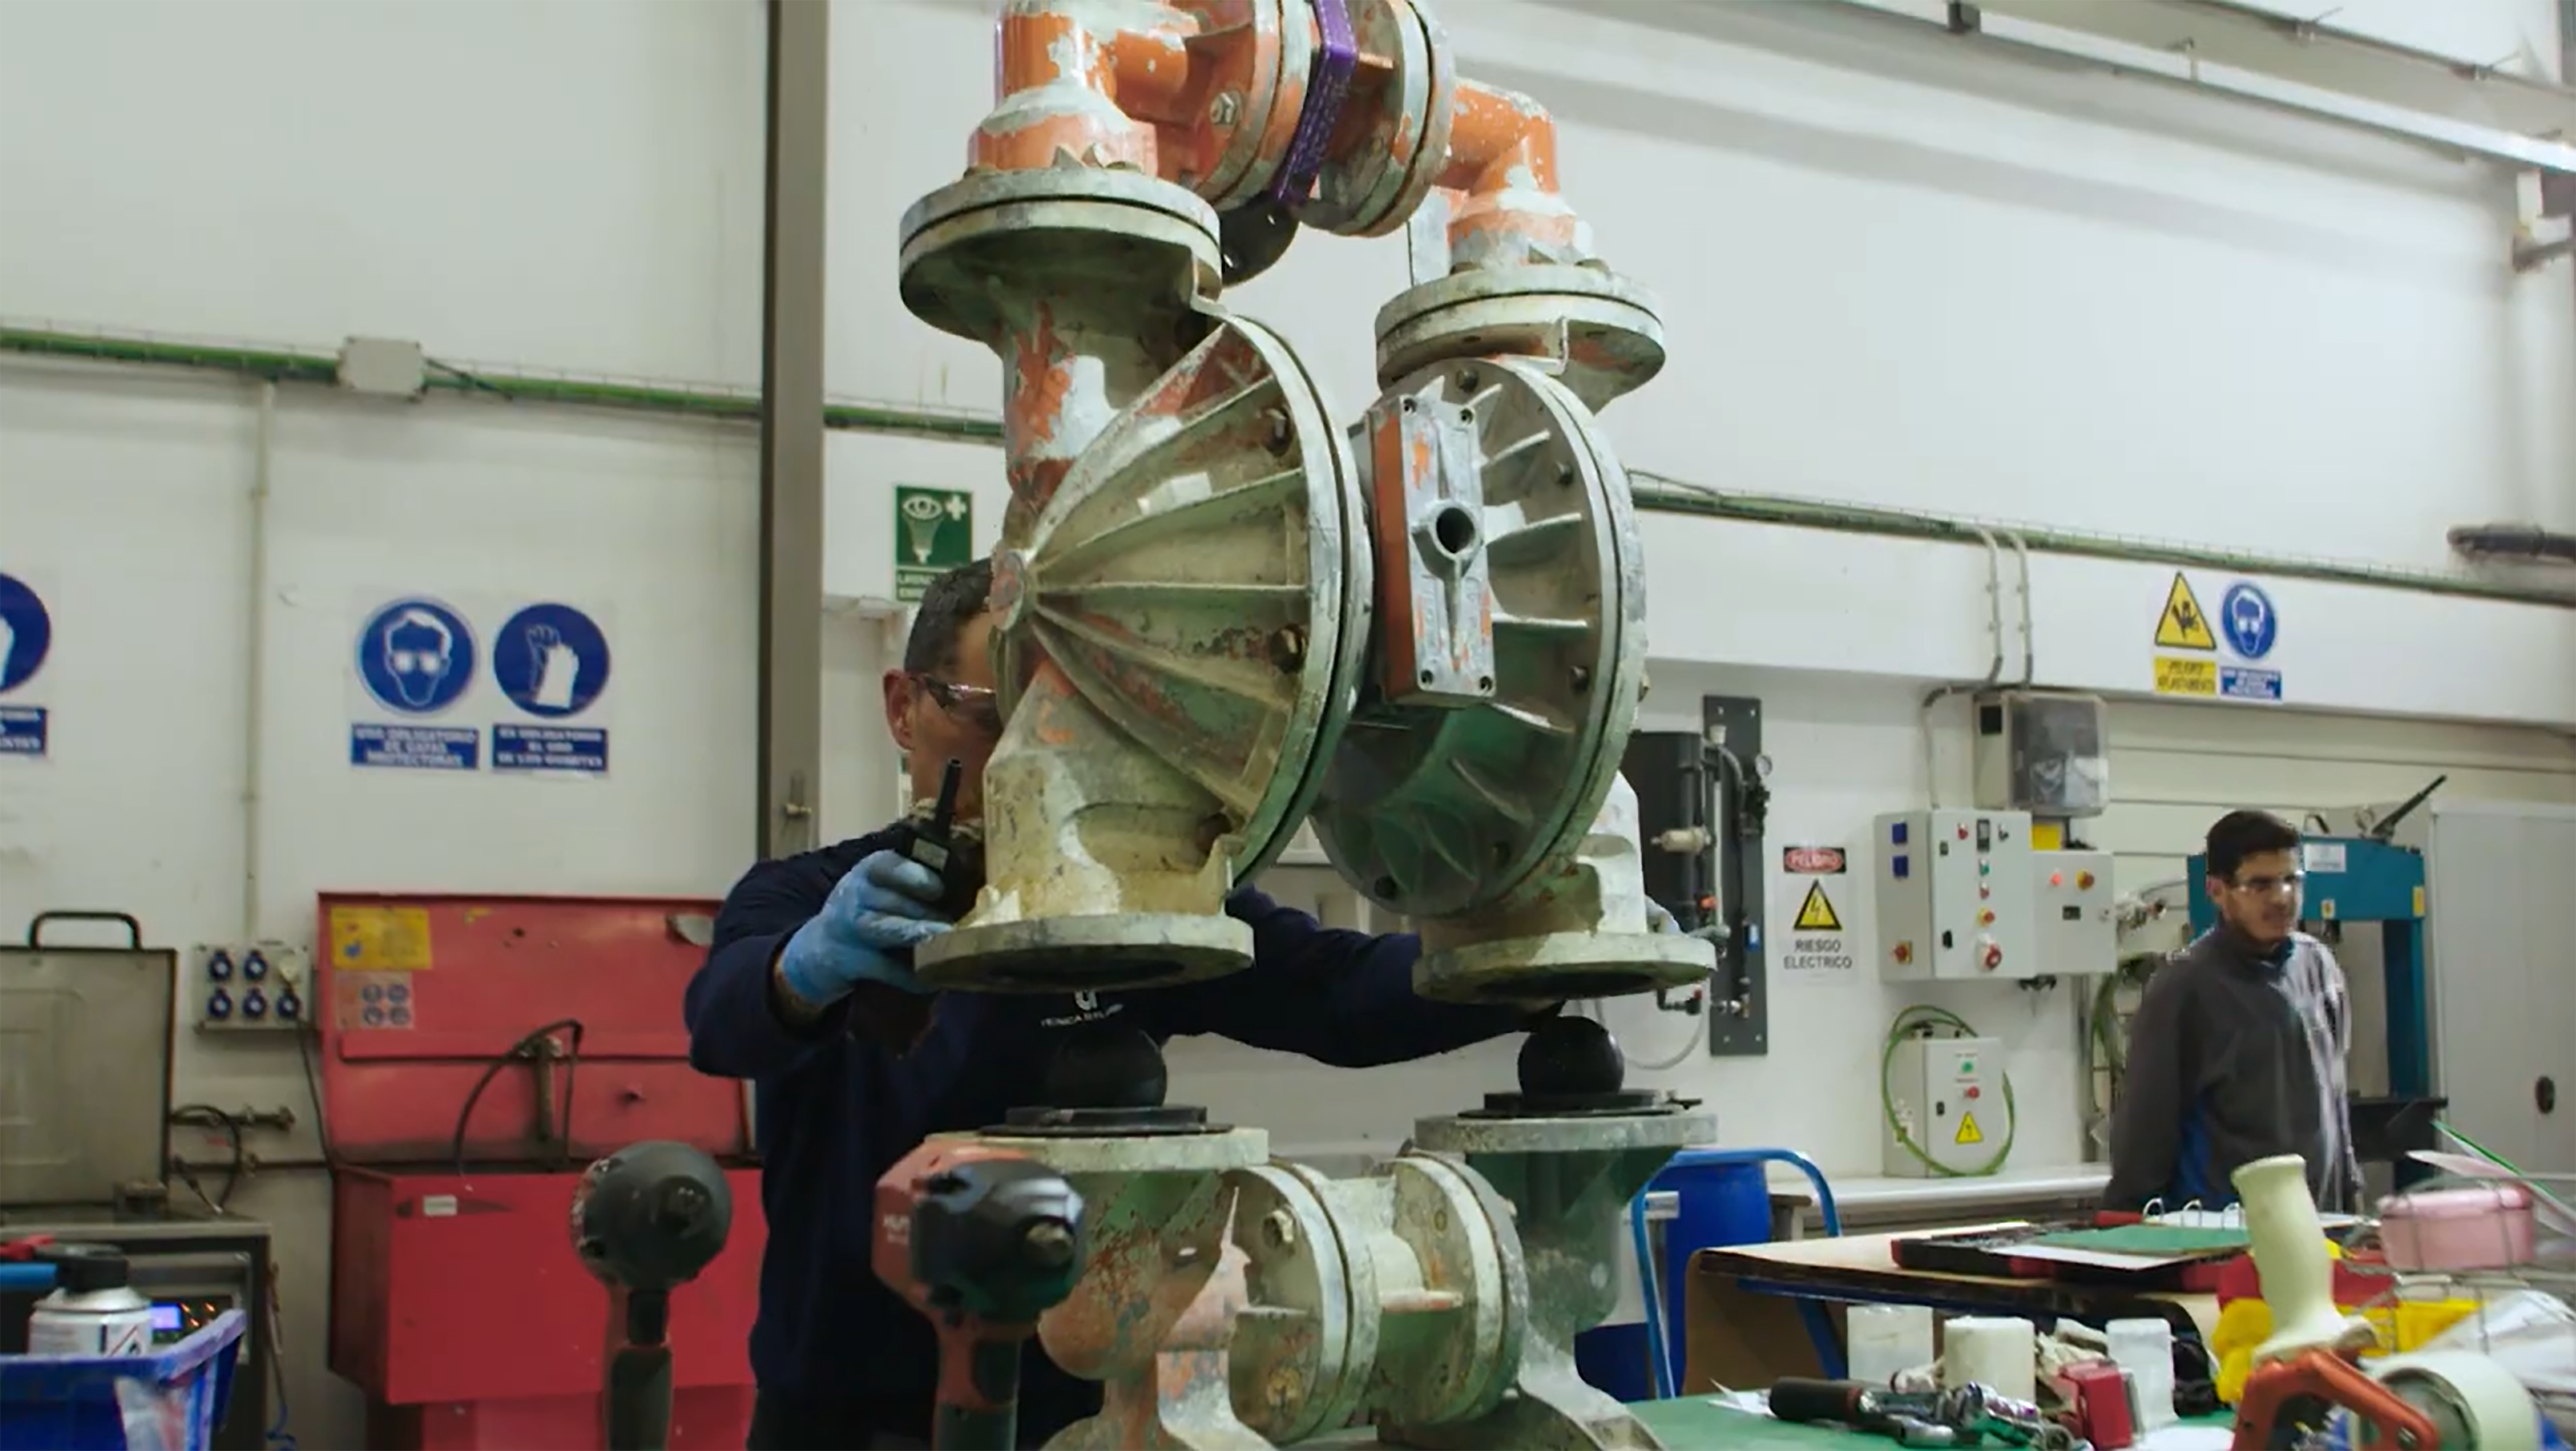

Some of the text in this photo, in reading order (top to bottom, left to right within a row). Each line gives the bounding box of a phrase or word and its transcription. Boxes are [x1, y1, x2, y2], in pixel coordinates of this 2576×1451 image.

[1790, 851, 1839, 868] PELIGRO
[1794, 939, 1842, 953] RIESGO
[1784, 955, 1853, 969] ELECTRICO
